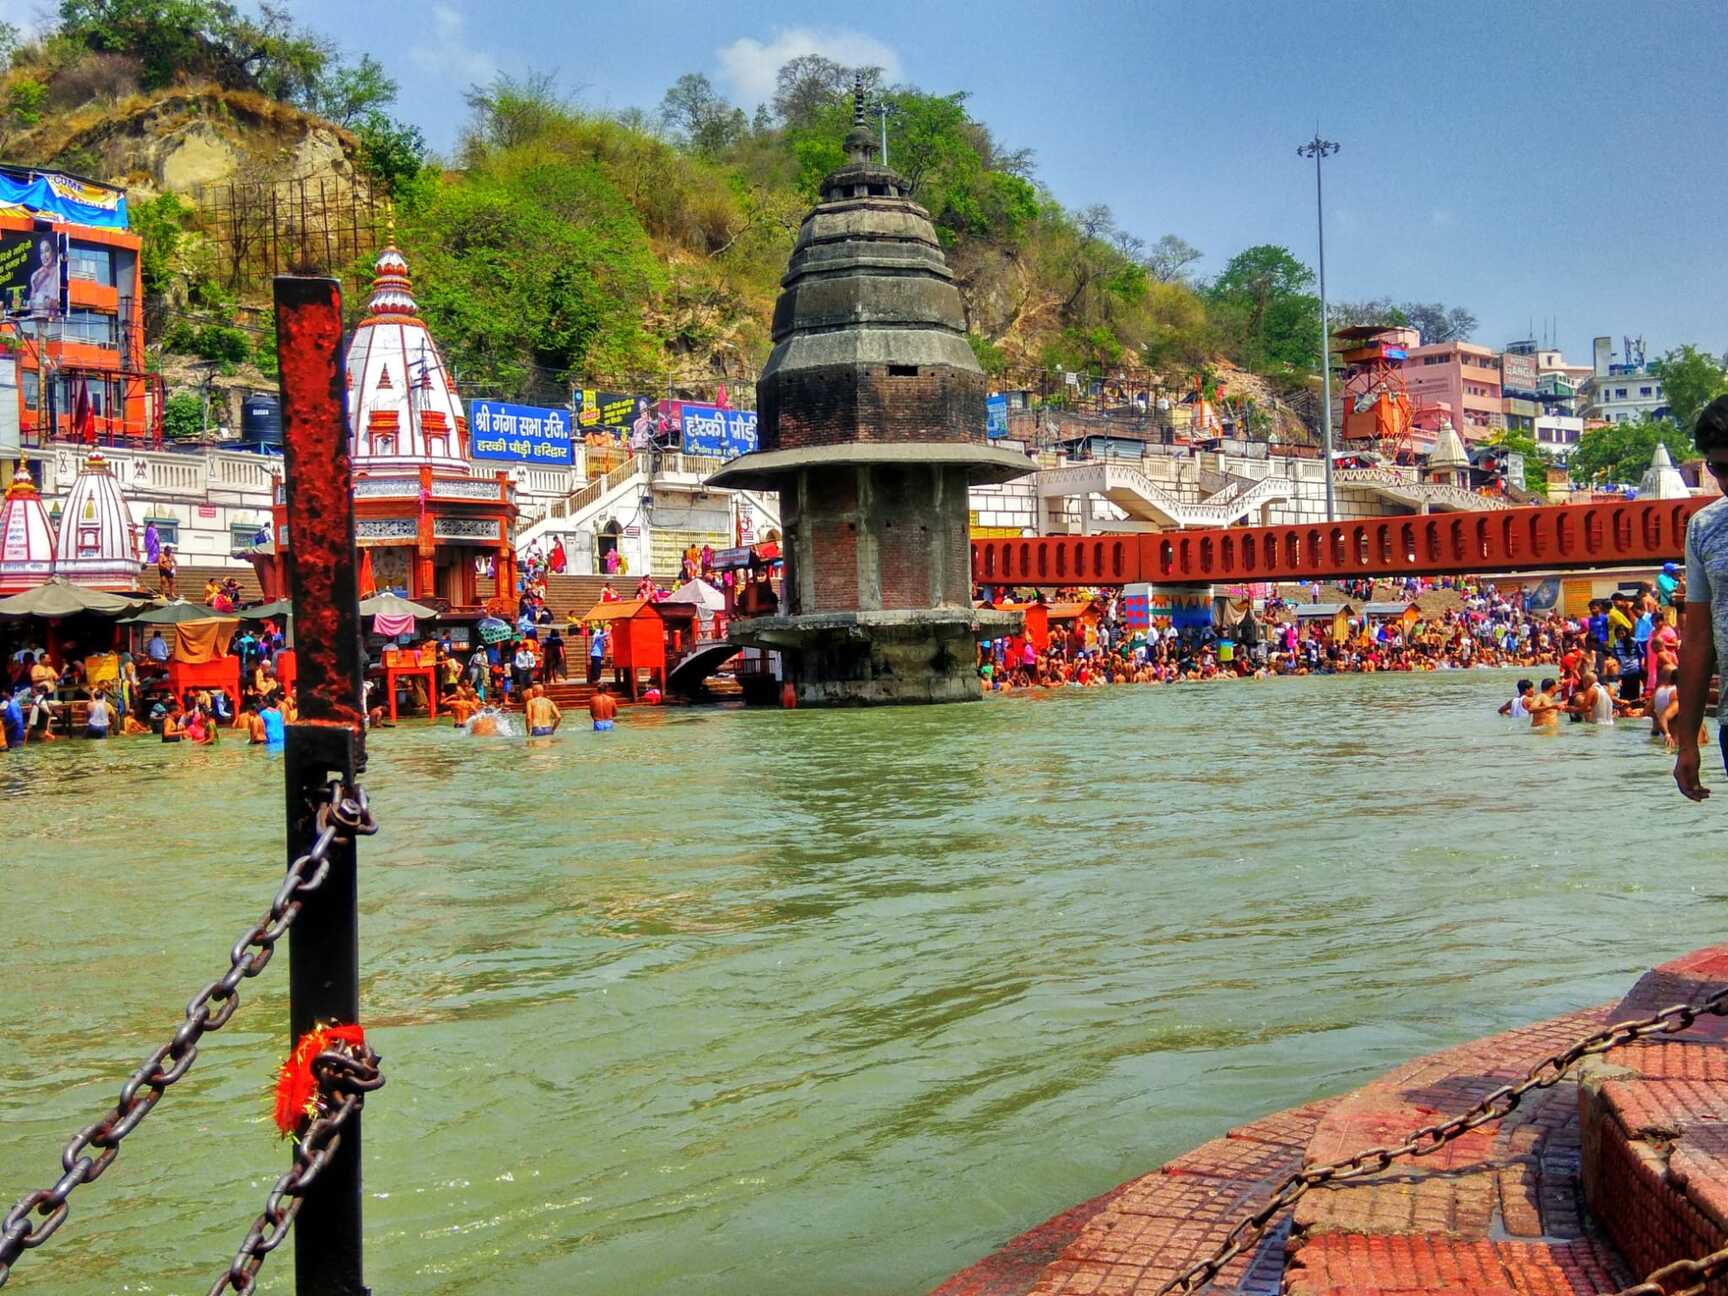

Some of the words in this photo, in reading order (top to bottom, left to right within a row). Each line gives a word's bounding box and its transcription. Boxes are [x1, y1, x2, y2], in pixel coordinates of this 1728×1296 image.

[476, 404, 490, 432] श्री
[492, 407, 517, 435] गंगा
[519, 416, 542, 437] सभा
[544, 411, 568, 439] रजि.
[477, 438, 506, 452] हरकी
[533, 442, 568, 457] हरिद्वार
